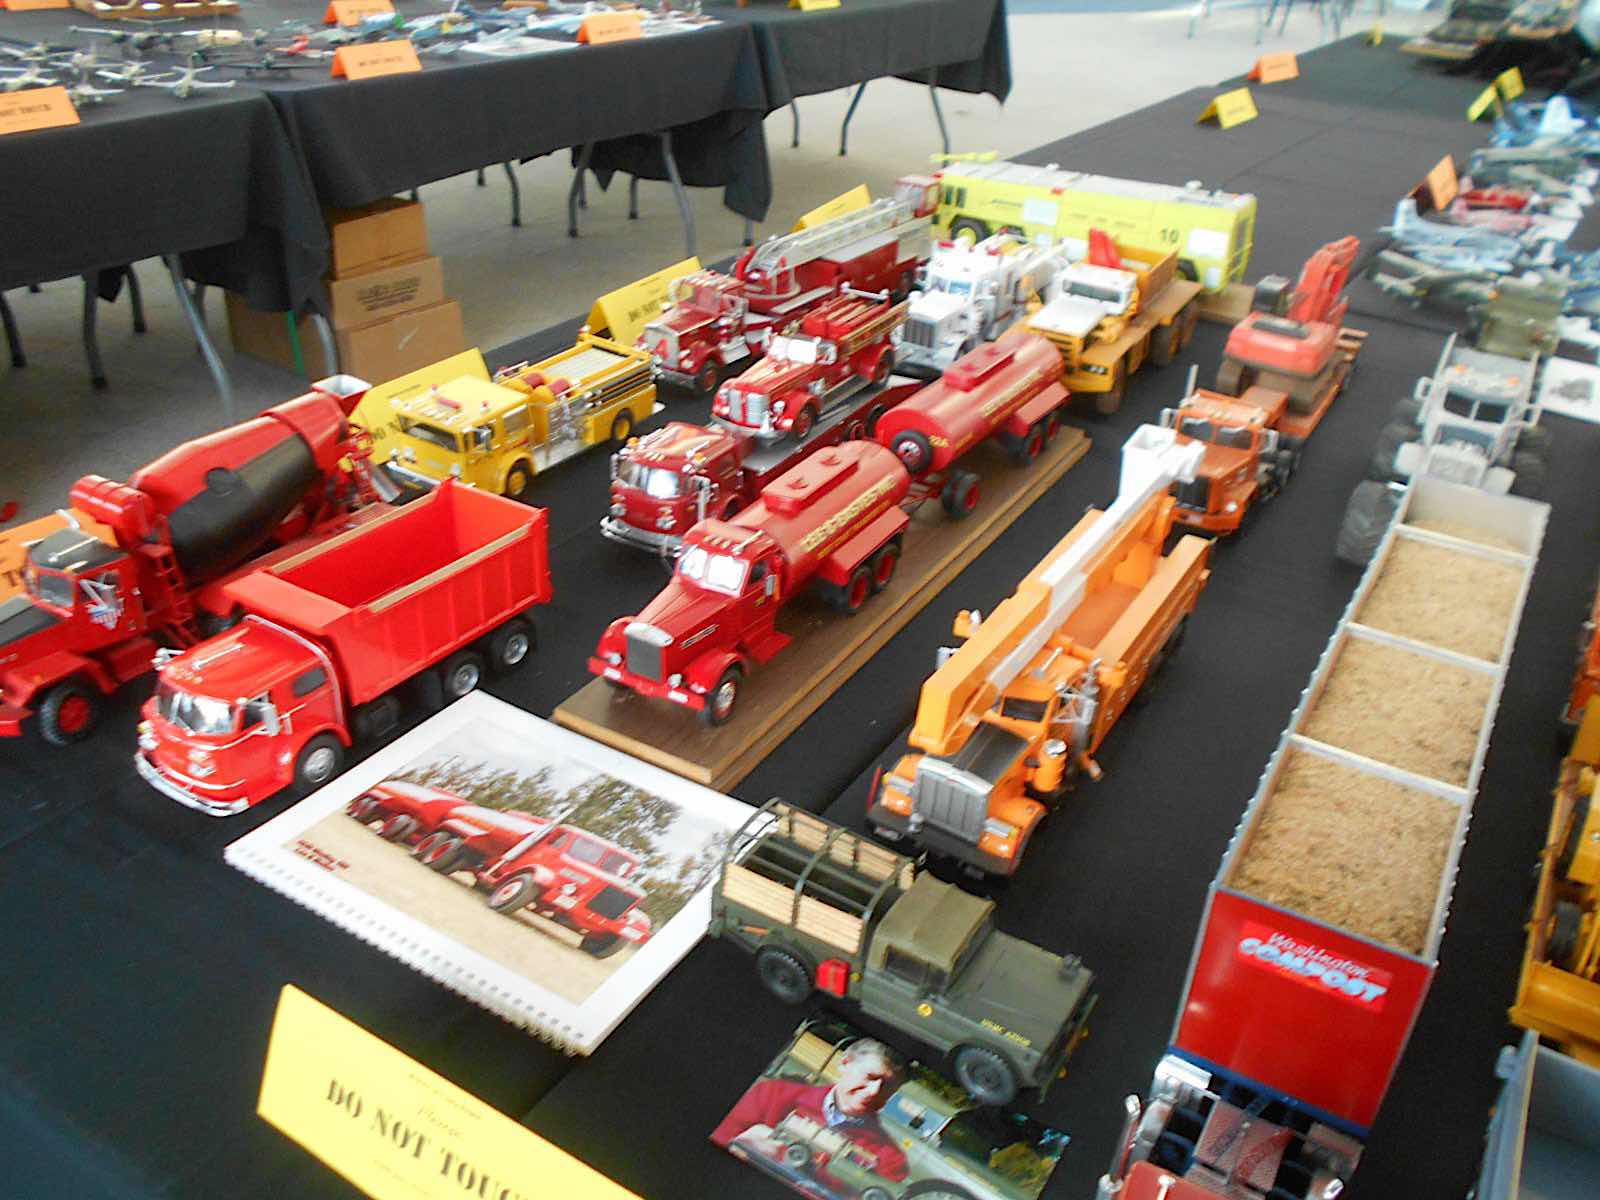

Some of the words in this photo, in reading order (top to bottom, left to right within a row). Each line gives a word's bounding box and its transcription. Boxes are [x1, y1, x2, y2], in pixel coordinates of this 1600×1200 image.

[1160, 227, 1181, 245] 10
[1240, 937, 1388, 1002] COMPOST
[1268, 931, 1370, 978] Washington
[325, 1077, 362, 1118] DO
[369, 1107, 432, 1159] NOT
[440, 1147, 528, 1200] TOU
